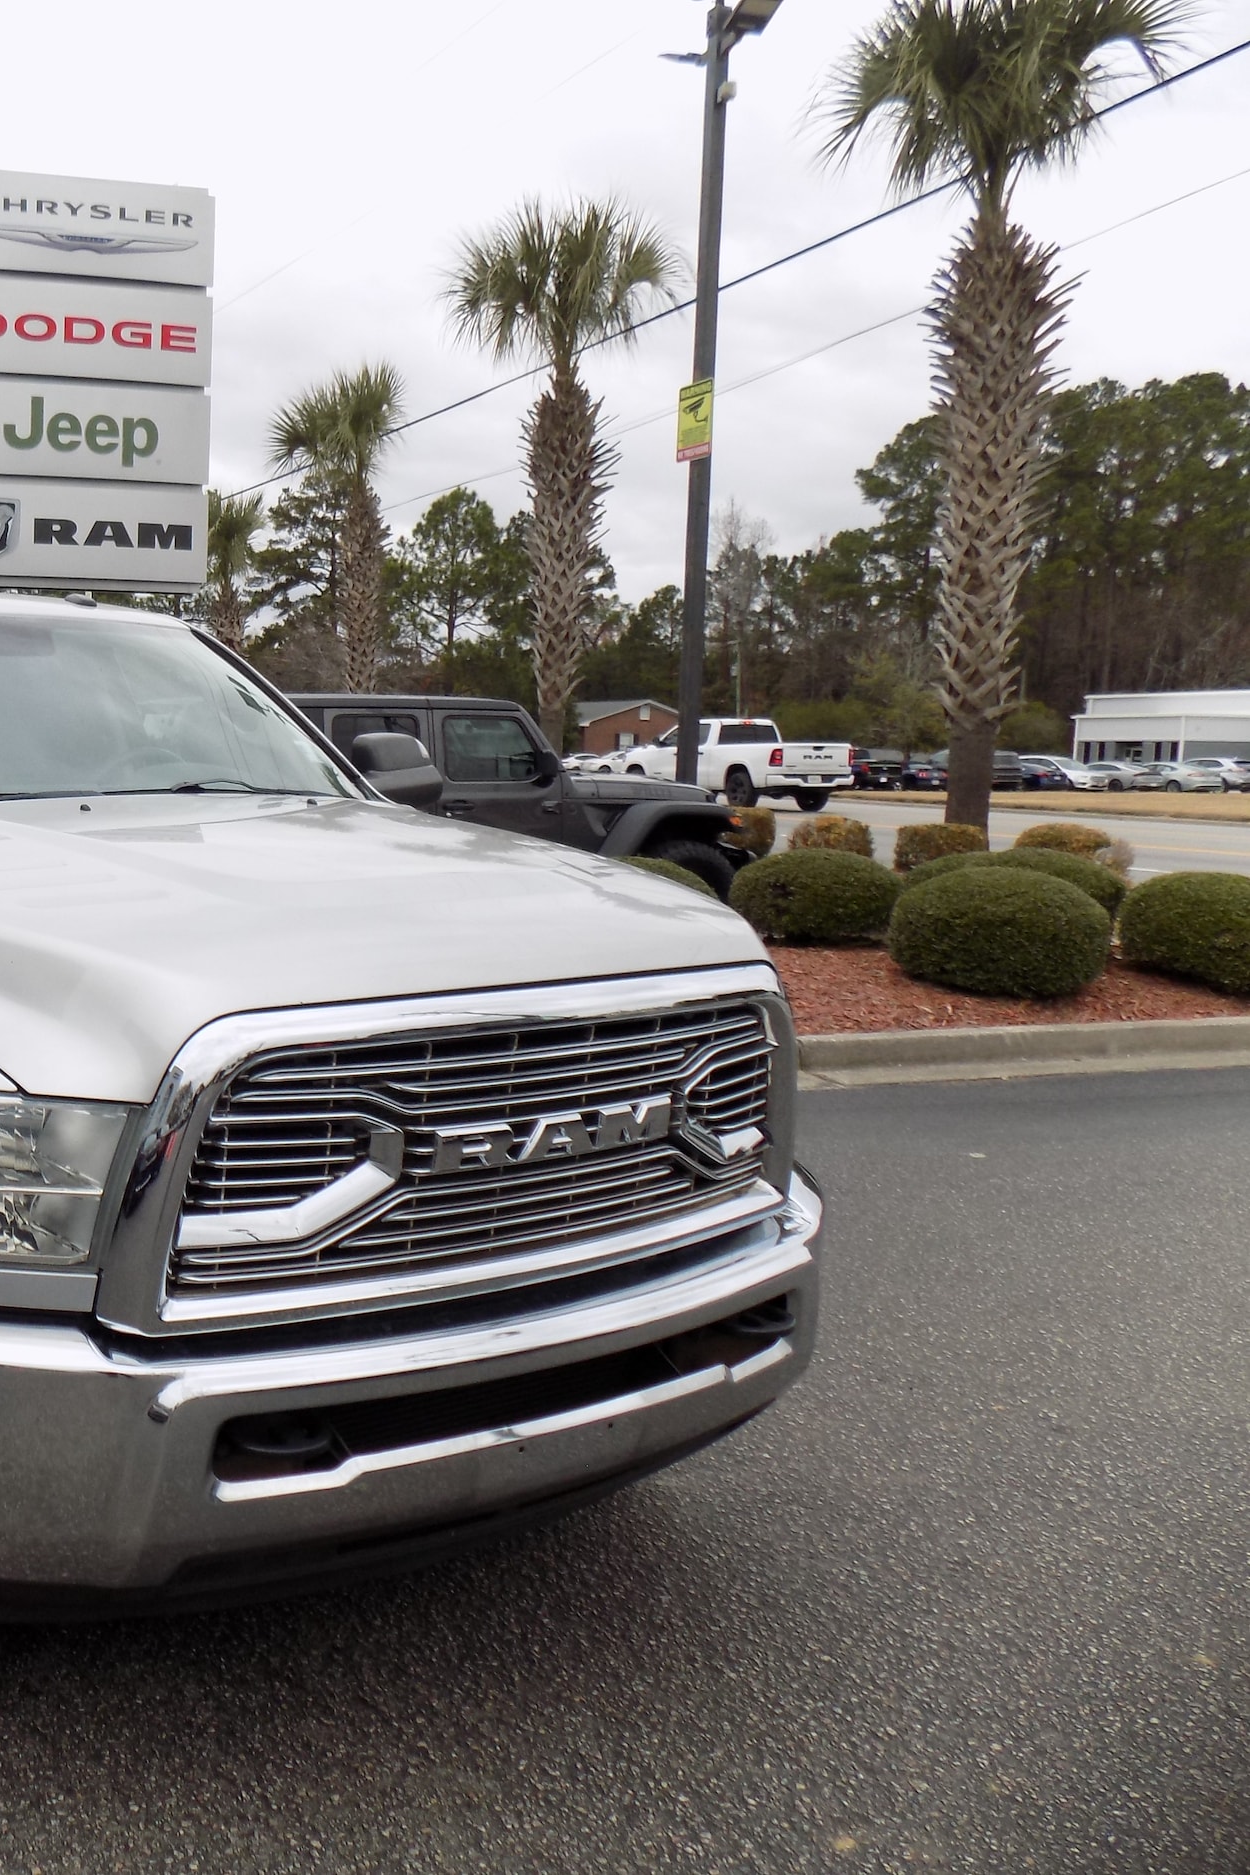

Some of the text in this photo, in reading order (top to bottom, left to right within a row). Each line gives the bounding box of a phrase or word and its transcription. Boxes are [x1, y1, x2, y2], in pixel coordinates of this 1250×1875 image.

[3, 396, 159, 467] Jeep
[33, 518, 192, 551] RAM
[433, 1095, 671, 1173] RAM
